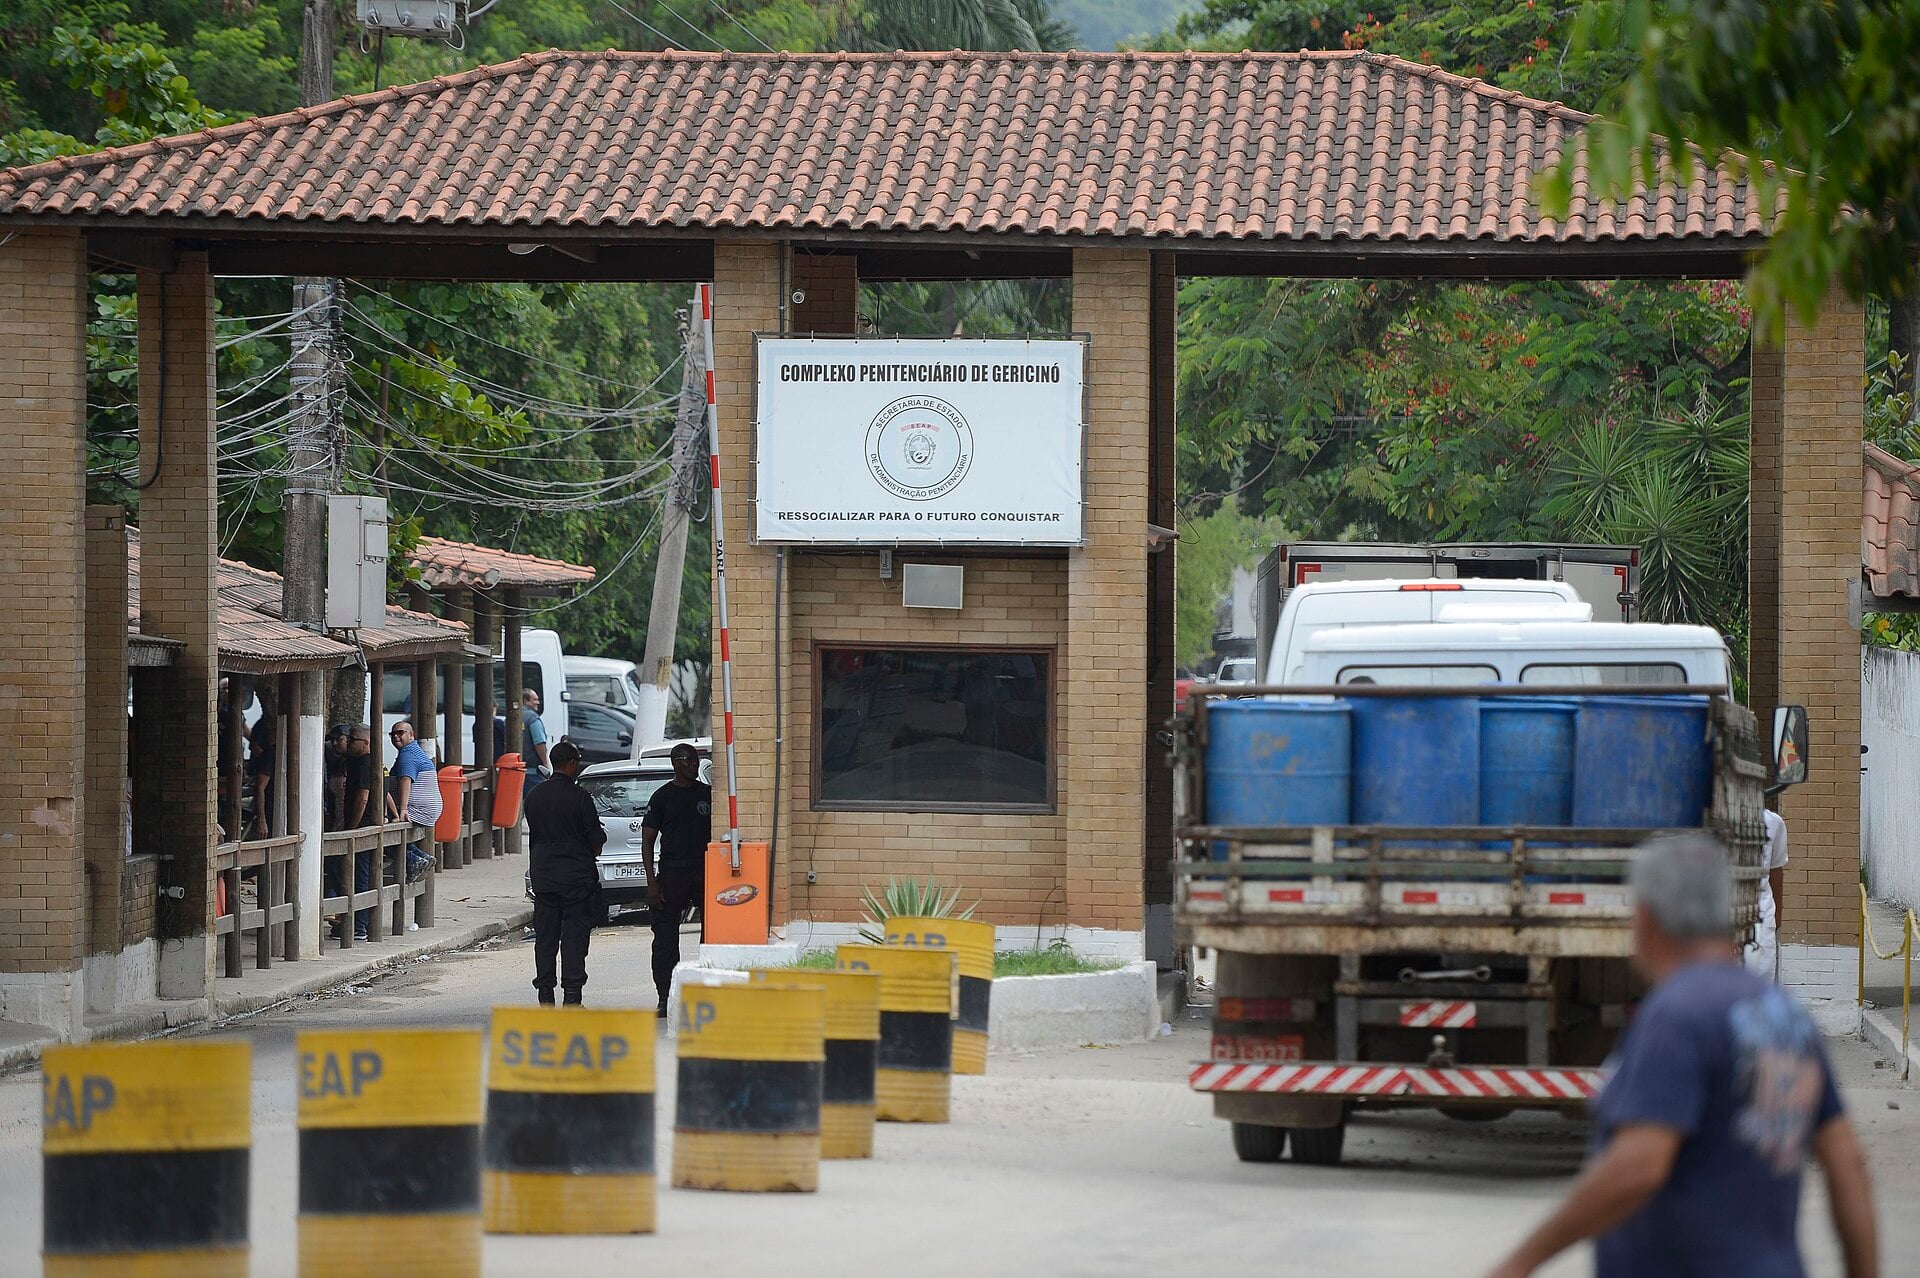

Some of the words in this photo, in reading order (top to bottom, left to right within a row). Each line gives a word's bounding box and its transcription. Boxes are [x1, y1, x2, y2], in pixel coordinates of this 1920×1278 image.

[780, 364, 856, 382] COMPLEXO
[860, 361, 967, 382] PENITENCIÁRIO
[971, 364, 988, 382] DE
[992, 362, 1060, 383] GERICINÓ
[875, 399, 921, 429] SECRETARIA
[923, 399, 935, 408] DE
[936, 403, 964, 429] ESTADO
[879, 512, 911, 521] PARA
[914, 512, 923, 521] O
[927, 512, 977, 521] FUTURO
[716, 539, 725, 577] PARE
[501, 1029, 629, 1070] SEAP
